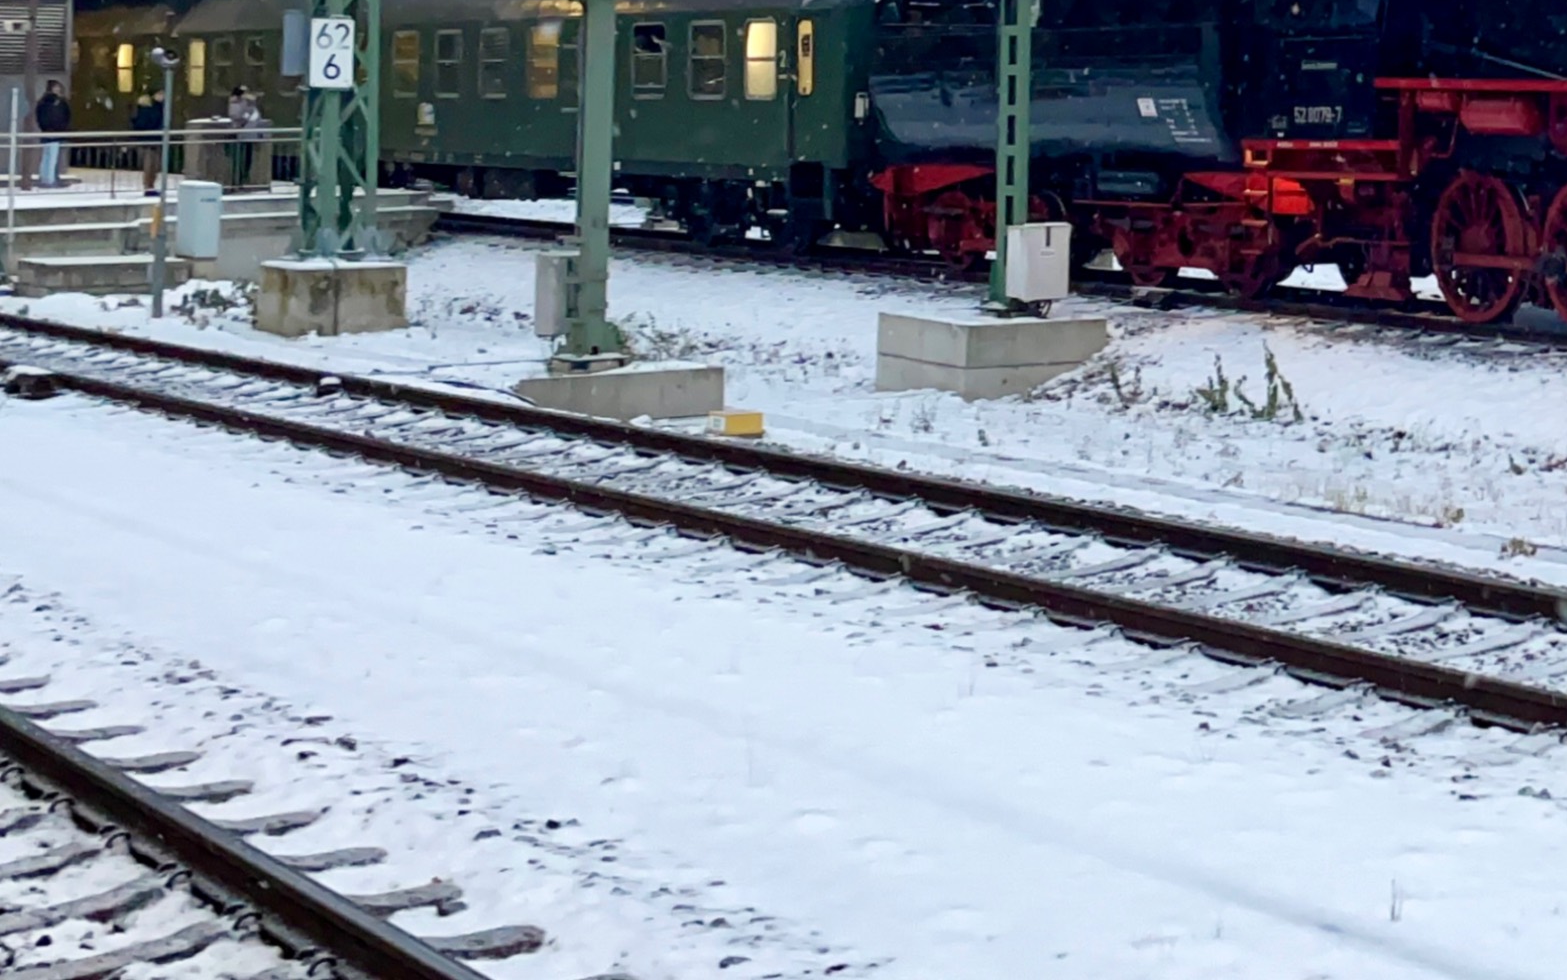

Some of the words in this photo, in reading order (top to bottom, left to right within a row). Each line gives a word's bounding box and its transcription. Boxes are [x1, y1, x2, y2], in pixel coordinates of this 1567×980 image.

[316, 23, 350, 49] 62
[323, 53, 341, 80] 6
[1294, 106, 1306, 124] 52
